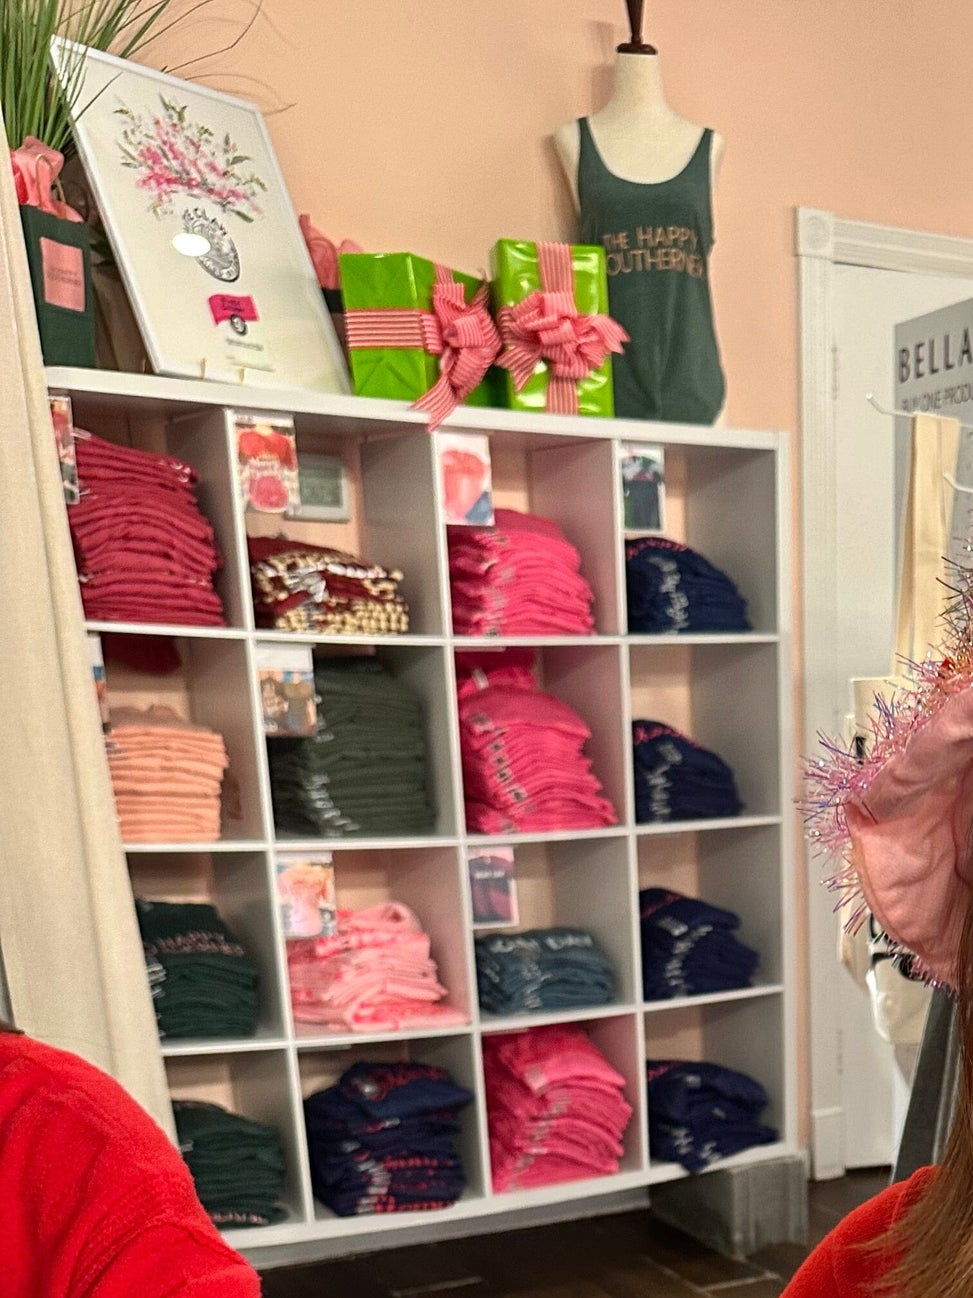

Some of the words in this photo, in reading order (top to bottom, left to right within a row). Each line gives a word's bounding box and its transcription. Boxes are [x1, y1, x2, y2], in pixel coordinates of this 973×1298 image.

[602, 231, 628, 249] THE
[636, 225, 698, 252] HAPPY
[898, 326, 973, 384] BELLA
